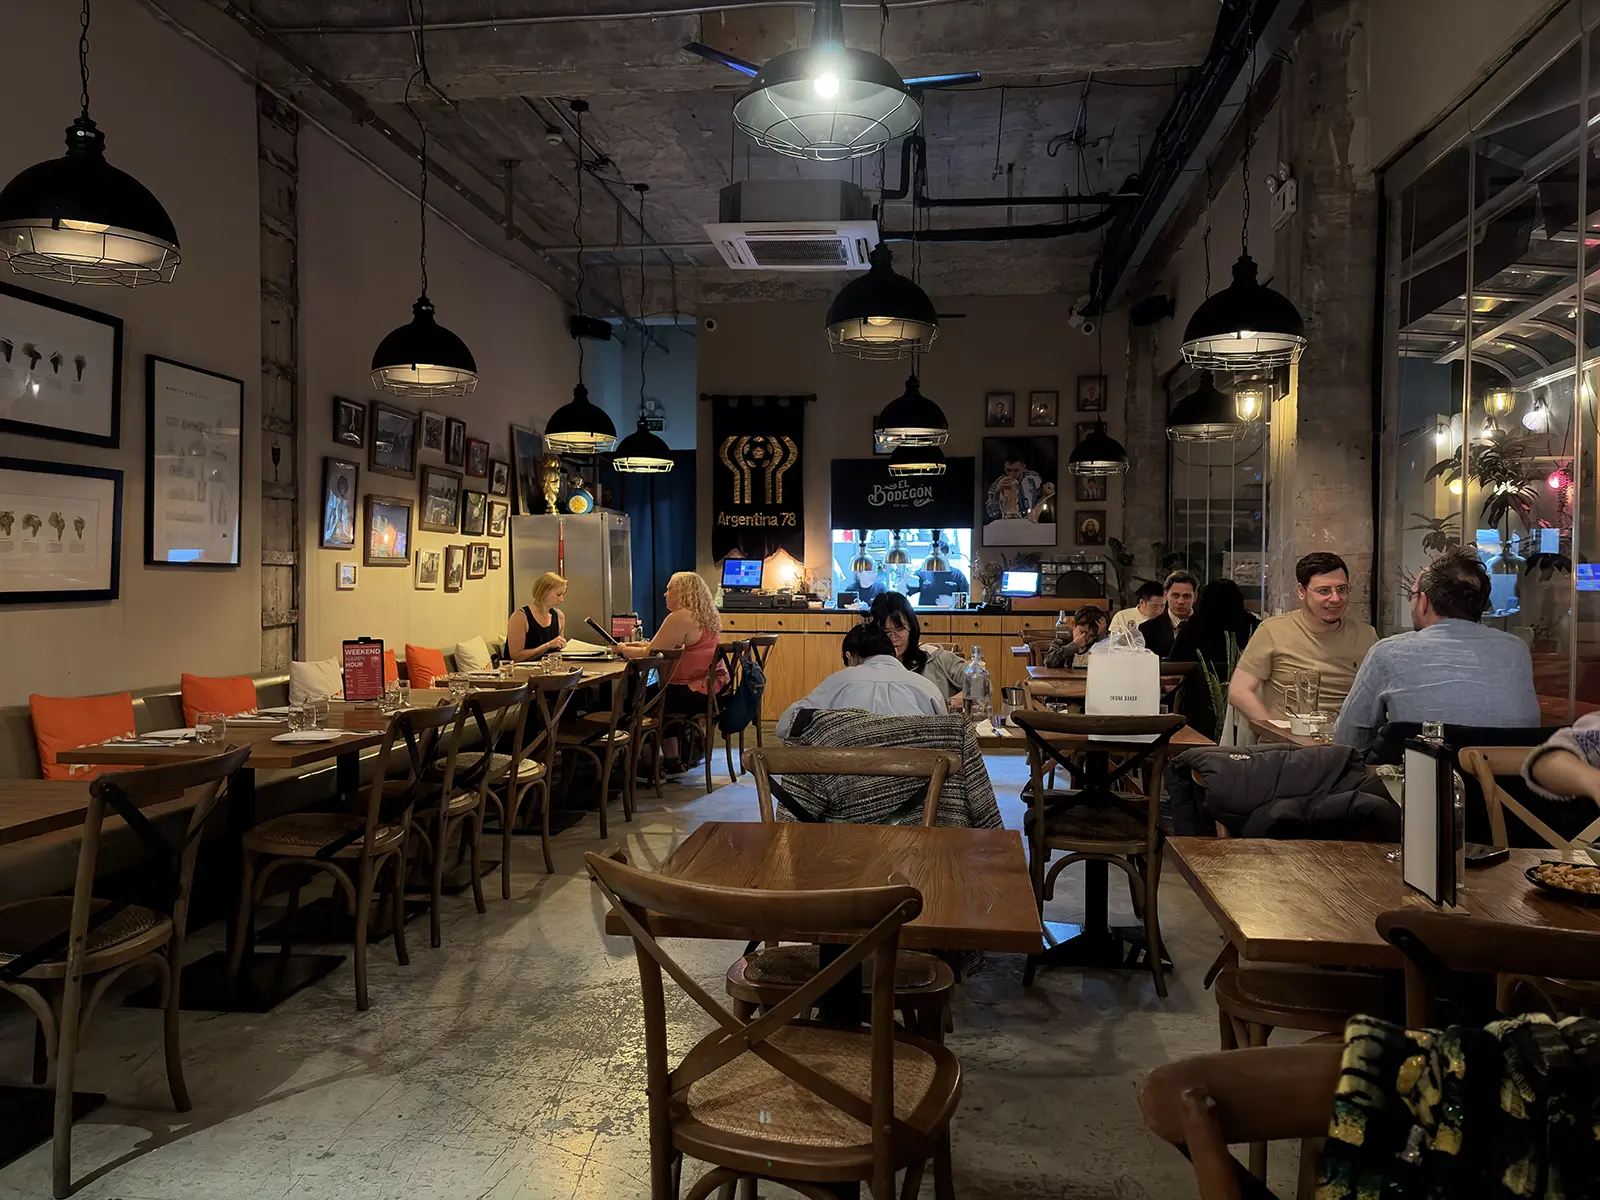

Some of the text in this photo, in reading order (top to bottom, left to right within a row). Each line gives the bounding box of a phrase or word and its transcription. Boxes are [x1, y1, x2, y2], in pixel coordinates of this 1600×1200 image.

[898, 479, 910, 489] EL
[717, 511, 779, 528] Argentina
[344, 648, 381, 656] WEEKEND
